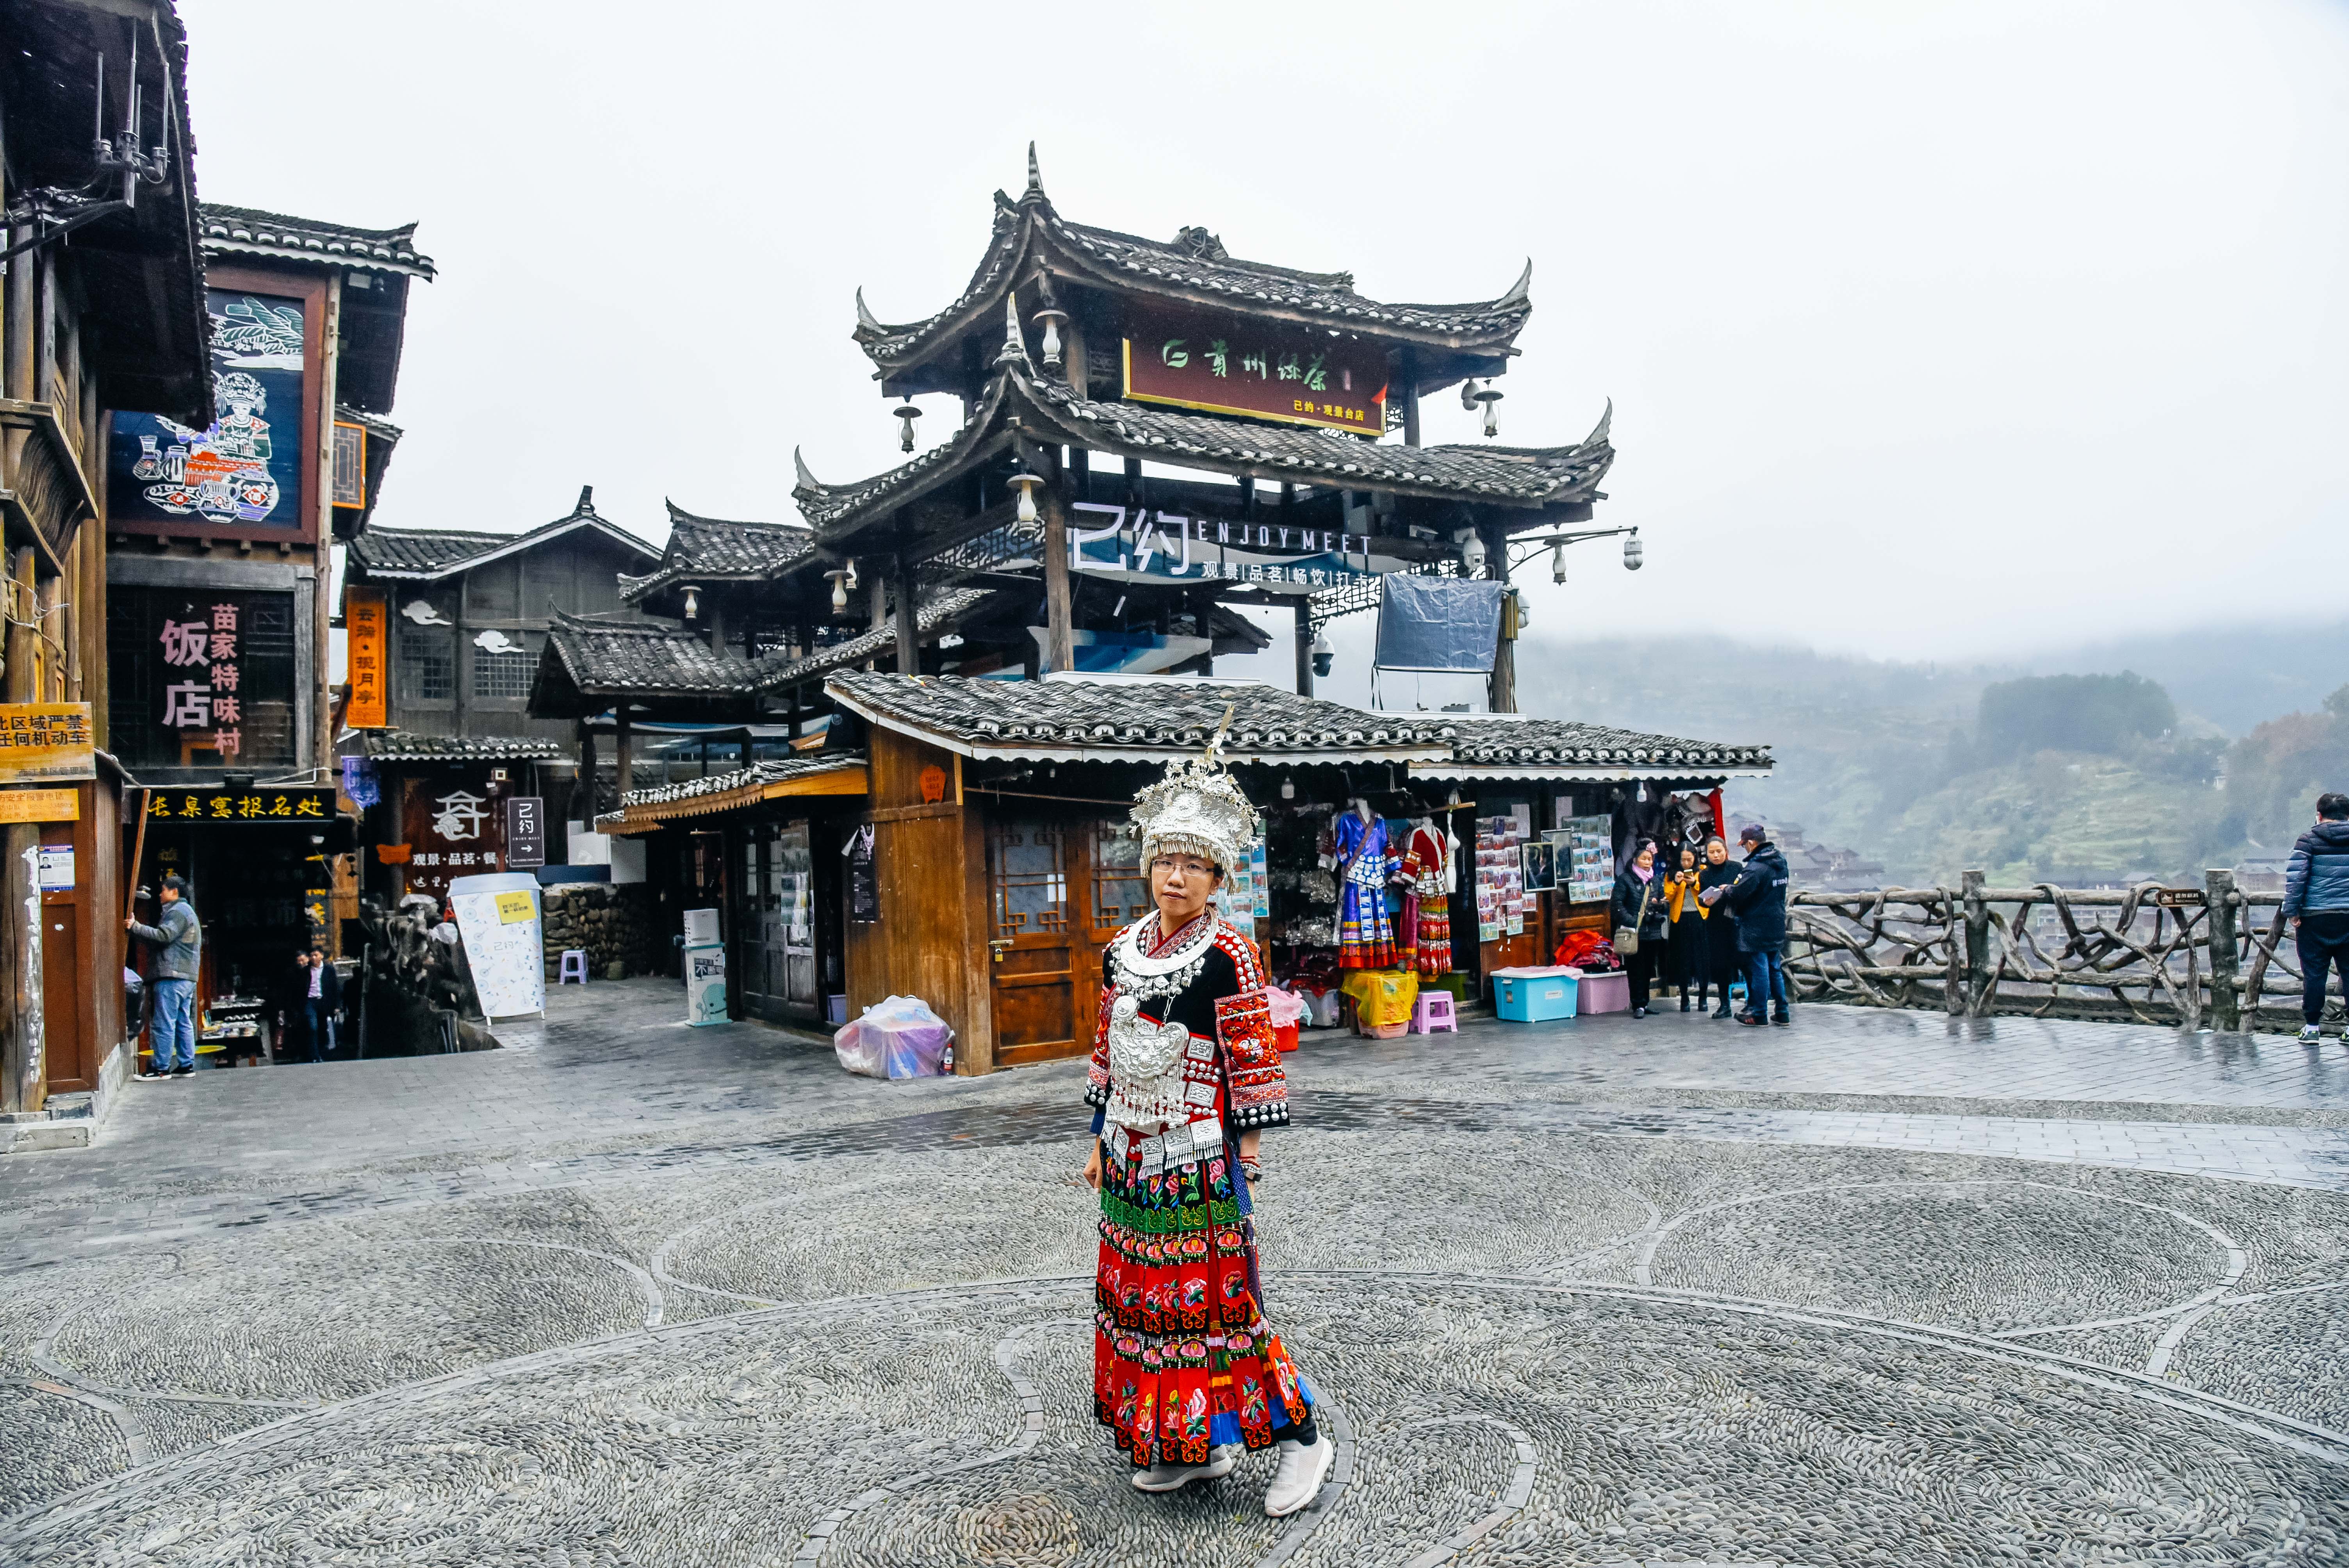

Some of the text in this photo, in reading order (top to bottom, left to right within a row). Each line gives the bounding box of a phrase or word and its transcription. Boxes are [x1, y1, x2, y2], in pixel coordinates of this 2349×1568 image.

[1198, 520, 1371, 555] ENJOY MEET
[159, 618, 211, 728] 饭店
[211, 603, 241, 756] 苗家特味村
[0, 731, 87, 747] 任何机动车
[148, 795, 324, 818] 长桌宴报名处
